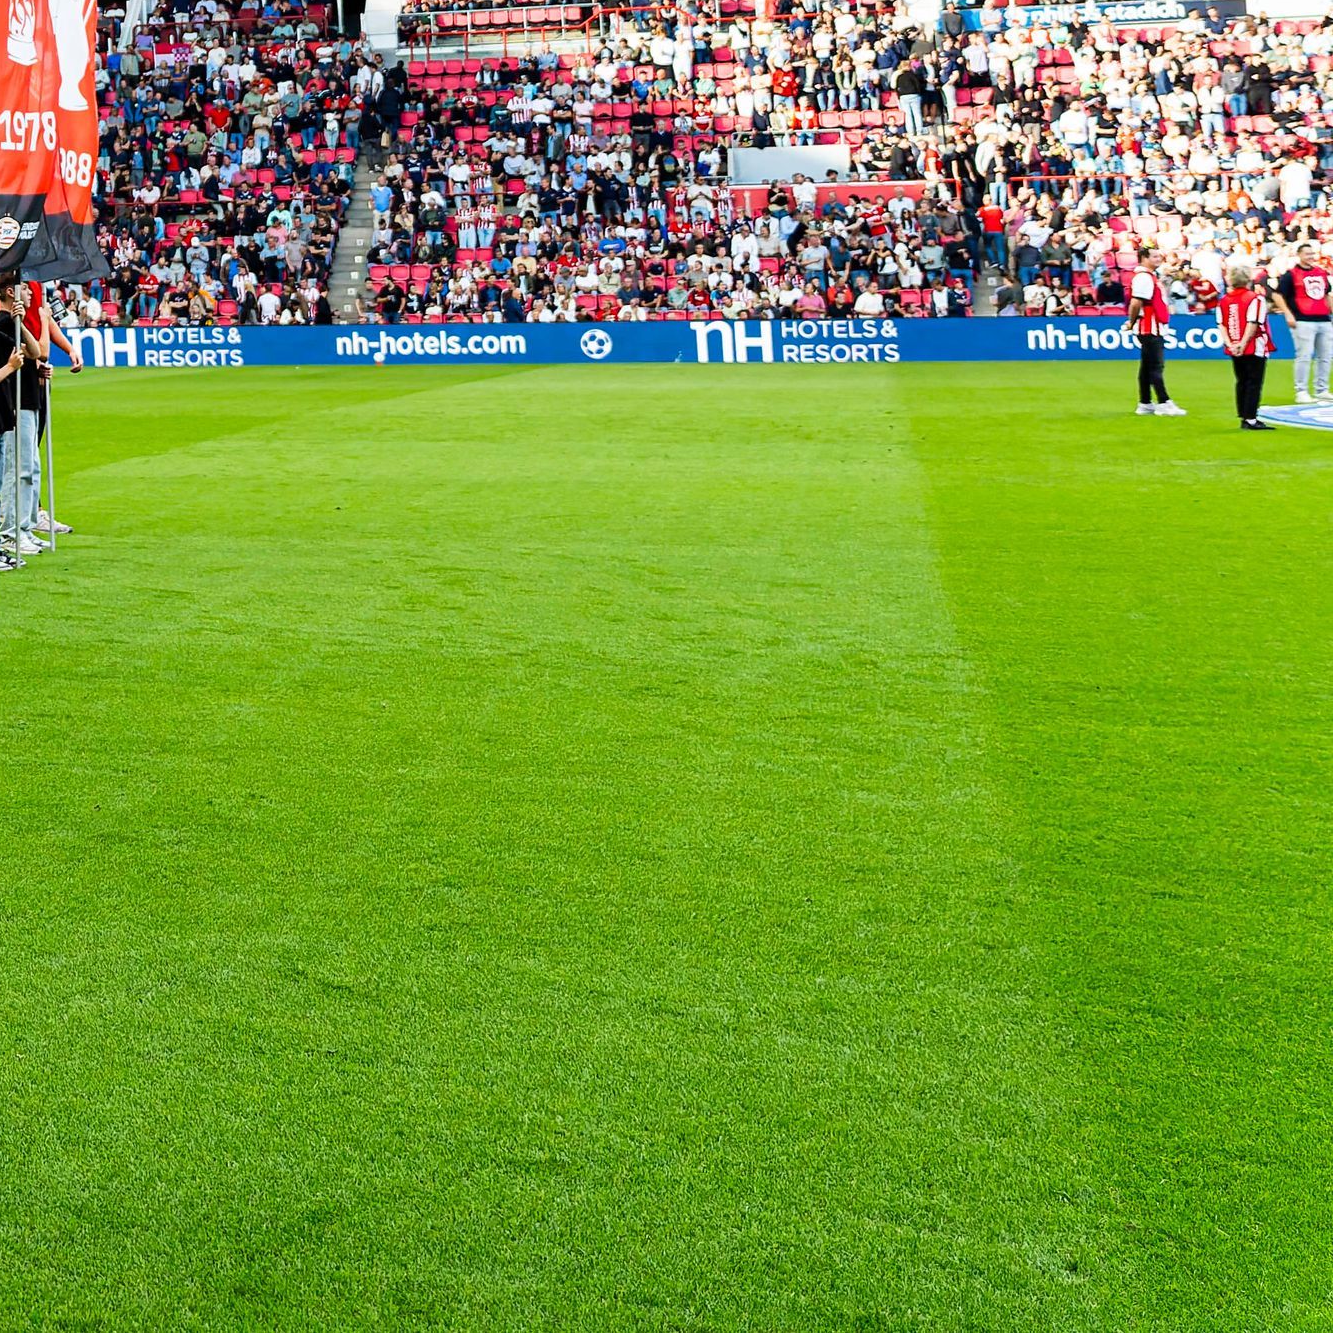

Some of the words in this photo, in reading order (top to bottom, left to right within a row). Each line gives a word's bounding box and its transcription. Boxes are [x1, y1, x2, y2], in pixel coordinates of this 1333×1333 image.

[0, 110, 57, 152] 1978
[144, 327, 224, 344] HOTELS
[227, 327, 242, 344] &
[781, 319, 878, 339] HOTELS
[880, 319, 899, 338] &
[336, 330, 527, 356] nh-hotels.com
[783, 343, 900, 363] RESORTS
[145, 349, 244, 367] RESORTS
